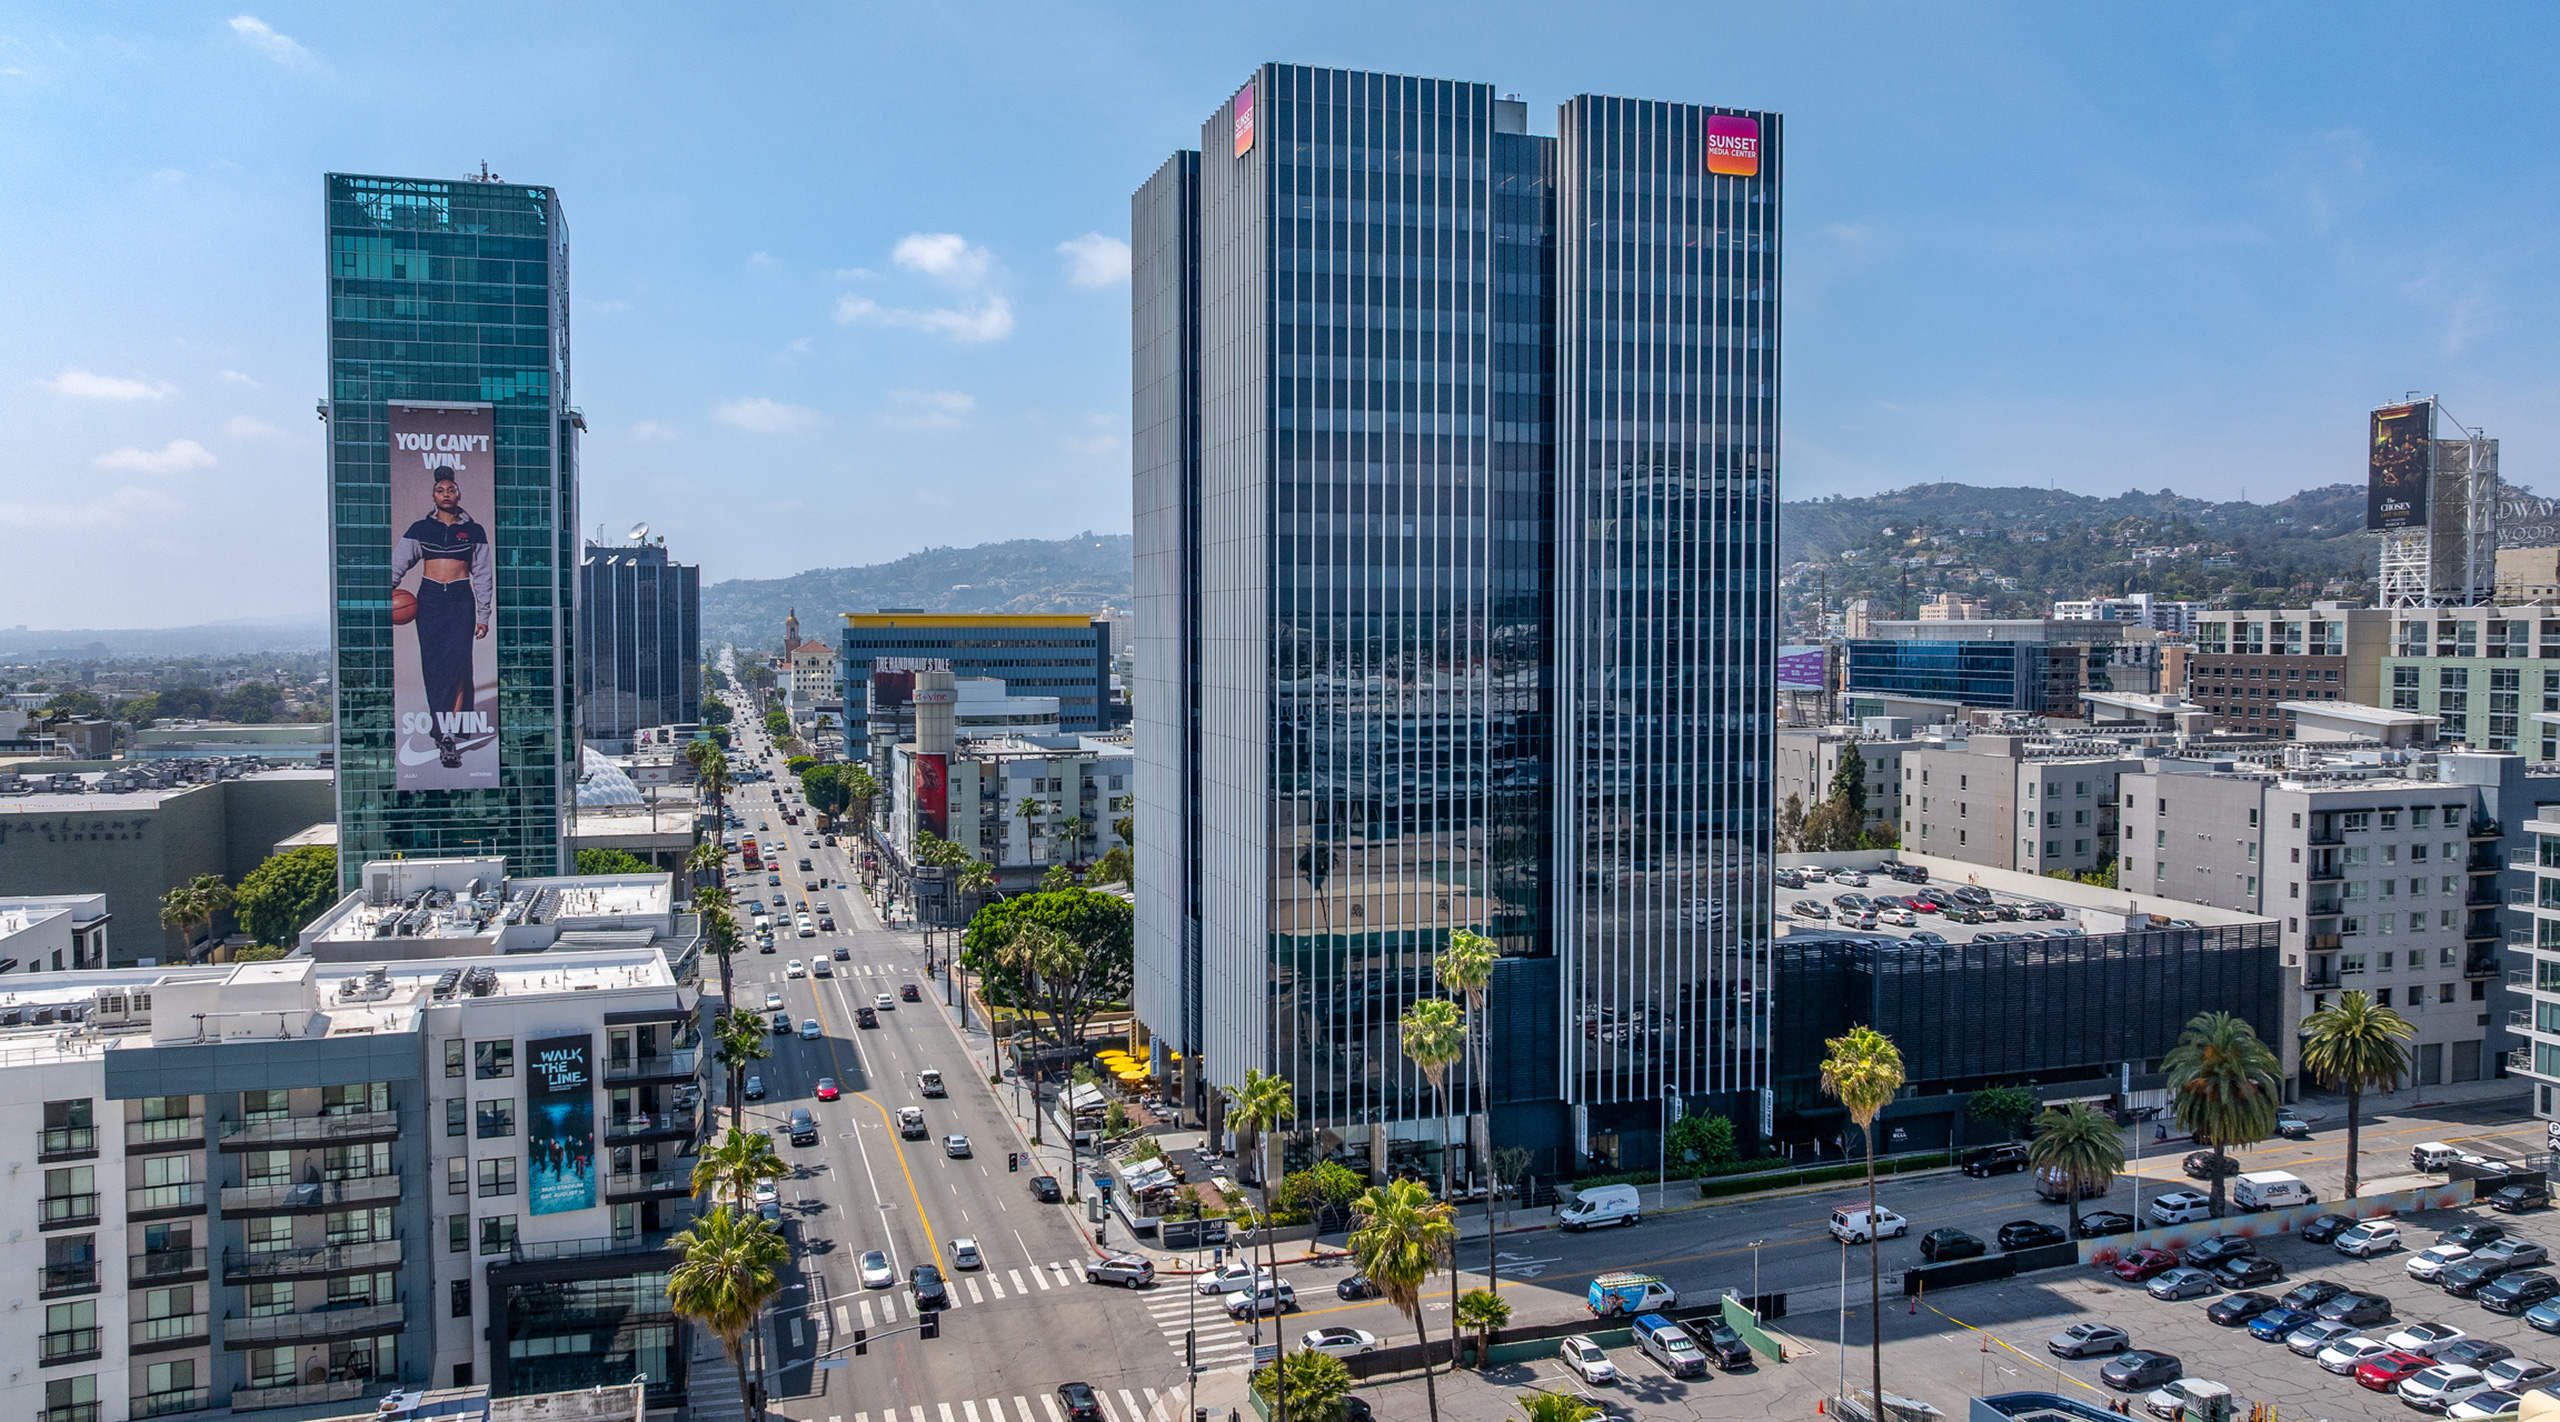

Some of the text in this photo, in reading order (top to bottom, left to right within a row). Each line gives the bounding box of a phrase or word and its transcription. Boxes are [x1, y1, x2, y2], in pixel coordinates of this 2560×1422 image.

[1709, 134, 1757, 151] SUNSET
[1709, 147, 1756, 158] MEDIA CENTER
[395, 433, 489, 452] YOU CAN'T
[422, 453, 467, 471] WIN.
[2380, 501, 2411, 511] CHOSEN
[876, 656, 950, 672] THE HANDMAID'S TALE
[402, 711, 495, 735] SO WIN.
[540, 1047, 583, 1063] WALK
[532, 1061, 568, 1074] THE
[549, 1071, 588, 1085] LINE
[553, 1190, 578, 1198] AUGUST
[556, 1183, 584, 1191] STADIUM
